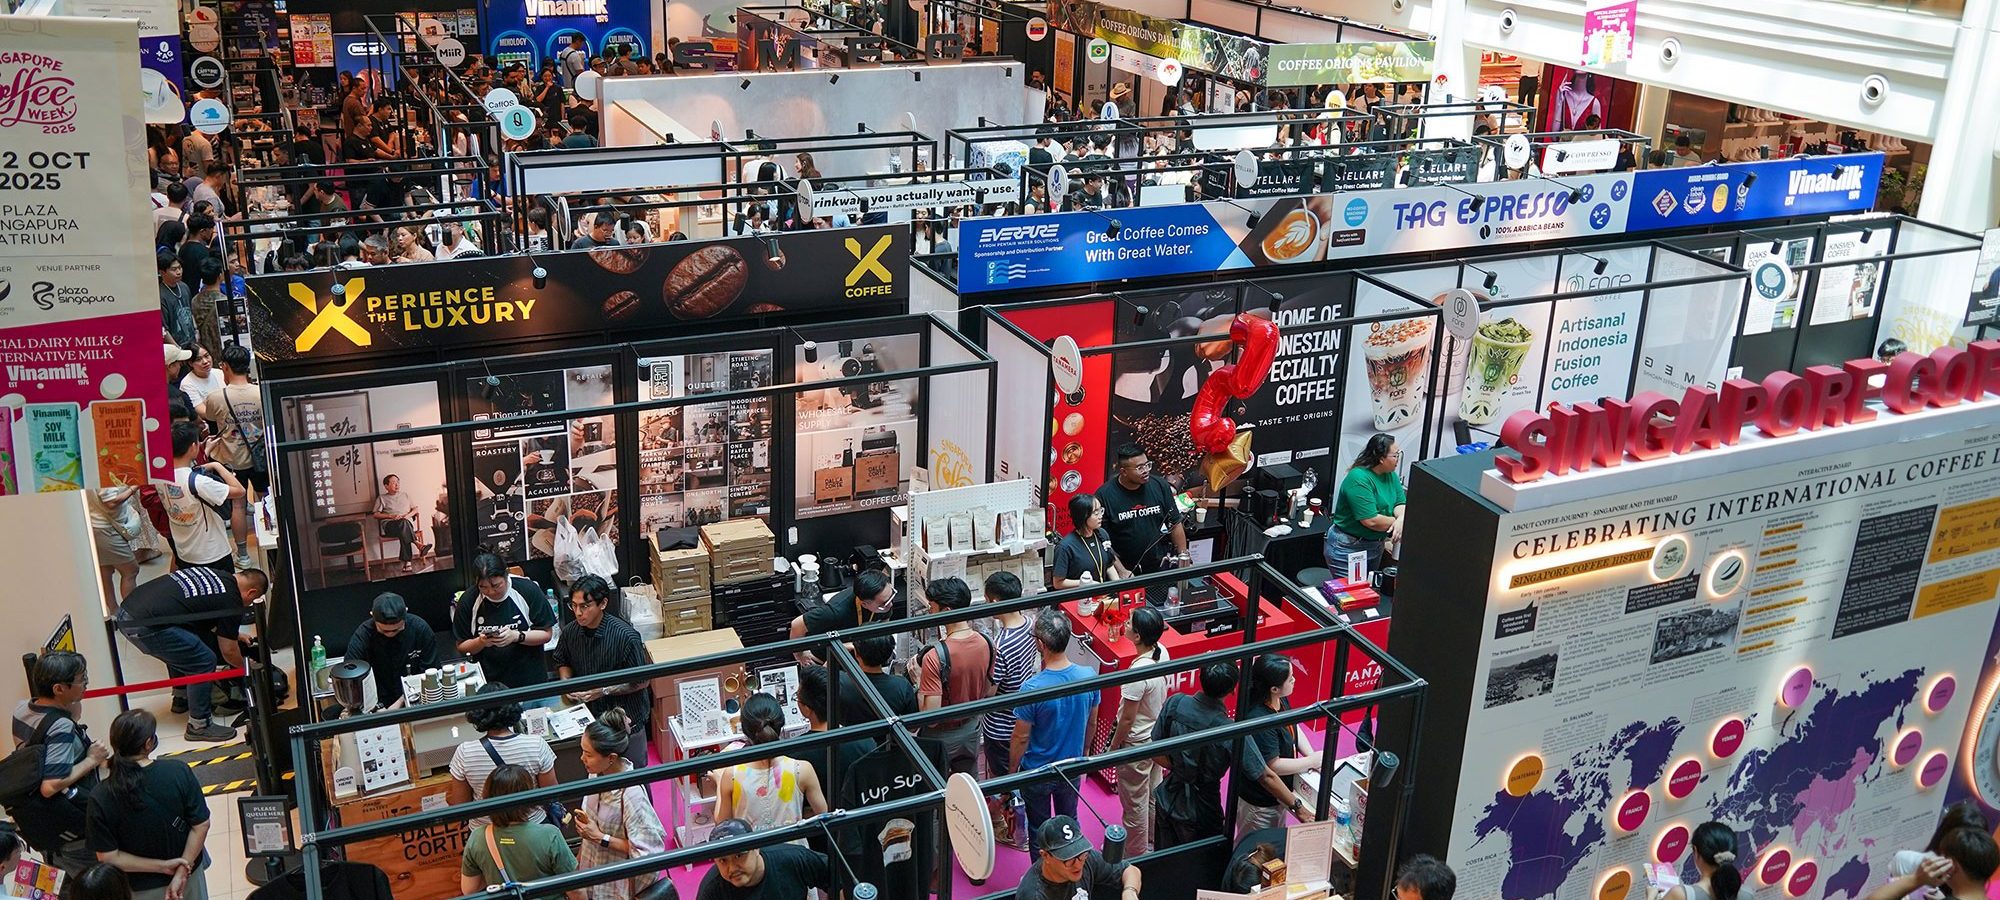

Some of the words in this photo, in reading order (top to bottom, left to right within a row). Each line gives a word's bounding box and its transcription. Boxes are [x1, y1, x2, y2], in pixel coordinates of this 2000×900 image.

[608, 34, 633, 43] CULINARY
[1100, 18, 1126, 37] COFFEE
[1127, 25, 1155, 44] ORIGINS
[1157, 32, 1192, 51] PAVILION
[439, 48, 462, 57] MiiR
[0, 52, 63, 71] GAPORE
[1278, 58, 1323, 72] COFFEE
[1325, 56, 1374, 71] ORIGINS
[1376, 54, 1426, 68] PAVILION
[43, 123, 76, 135] 2025
[28, 151, 91, 170] OCT
[0, 172, 61, 191] 2025
[1253, 173, 1291, 185] TELLAR
[871, 194, 892, 206] you
[896, 188, 944, 202] actually
[946, 188, 975, 198] want
[992, 185, 1015, 194] use.
[1284, 185, 1299, 193] Maker
[3, 204, 58, 216] PLAZA
[1394, 200, 1447, 231] TAG
[979, 224, 1060, 243] EVERPURE
[1123, 226, 1156, 242] Coffee
[1158, 224, 1209, 238] Comes
[1495, 226, 1512, 234] 100%
[1512, 224, 1542, 233] ARABICA
[1543, 222, 1565, 231] BEANS
[0, 233, 65, 245] ATRIUM
[974, 249, 1006, 258] Sponsorship
[1016, 246, 1045, 254] Distribution
[1085, 246, 1115, 263] With
[1117, 245, 1152, 261] Great
[1154, 243, 1193, 258] Water.
[1748, 250, 1767, 260] OAKS
[57, 286, 89, 296] plaza
[845, 285, 893, 299] COFFEE
[1758, 284, 1778, 296] OAKS
[58, 295, 115, 306] singapura
[368, 311, 397, 323] THE
[404, 299, 536, 332] LUXURY
[1272, 307, 1316, 327] HOME
[1320, 304, 1342, 322] OF
[1560, 313, 1626, 334] Artisanal
[28, 337, 72, 348] DAIRY
[75, 336, 110, 347] MILK
[112, 335, 124, 345] &
[1557, 331, 1628, 353] Indonesia
[79, 349, 114, 360] MILK
[1270, 354, 1339, 382] ECIALTY
[1554, 353, 1601, 372] Fusion
[6, 363, 88, 381] Vinamilk
[576, 373, 602, 381] RETAIL
[687, 381, 726, 390] OUTLETS
[1551, 371, 1599, 392] Coffee
[1276, 379, 1336, 406] COFFEE
[32, 409, 72, 418] Vinamilk
[98, 405, 136, 415] Vinamilk
[798, 406, 852, 419] WHOLESALE
[105, 419, 133, 429] PLANT
[1258, 418, 1283, 427] TASTE
[1286, 415, 1301, 423] THE
[1303, 410, 1333, 420] ORIGINS
[1495, 357, 1888, 482] SINGAPORE
[45, 422, 62, 432] SOY
[798, 421, 832, 430] SUPPLY
[43, 431, 66, 443] MILK
[109, 429, 131, 439] MILK
[476, 447, 517, 457] ROASTERY
[1798, 465, 1832, 477] INTERACTIVE
[527, 486, 568, 496] ACADEMIA
[860, 496, 891, 507] COFFEE
[1512, 506, 1697, 560] CELEBRATING
[1706, 468, 1898, 522] INTERNATIONAL
[1905, 450, 1986, 482] COFFEE
[1118, 510, 1137, 521] DRAFT
[1138, 505, 1161, 517] COFFEE
[1512, 522, 1536, 532] ABOUT
[1535, 518, 1560, 529] COFFEE
[1559, 511, 1589, 524] JOURNEY
[1593, 505, 1630, 517] SINGAPORE
[1630, 502, 1643, 511] AND
[1512, 566, 1570, 586] SINGAPORE
[1572, 557, 1610, 576] COFFEE
[1612, 549, 1651, 567] HISTORY
[335, 775, 354, 783] ORDER
[1511, 769, 1540, 782] GUATEMALA
[1670, 772, 1700, 785] NETHERLANDS
[245, 811, 268, 819] QUEUE
[1625, 806, 1643, 816] FRANCE
[1062, 824, 1075, 841] S
[1667, 840, 1680, 849] ITALY
[1465, 857, 1483, 866] COSTA
[1484, 853, 1497, 862] RICA
